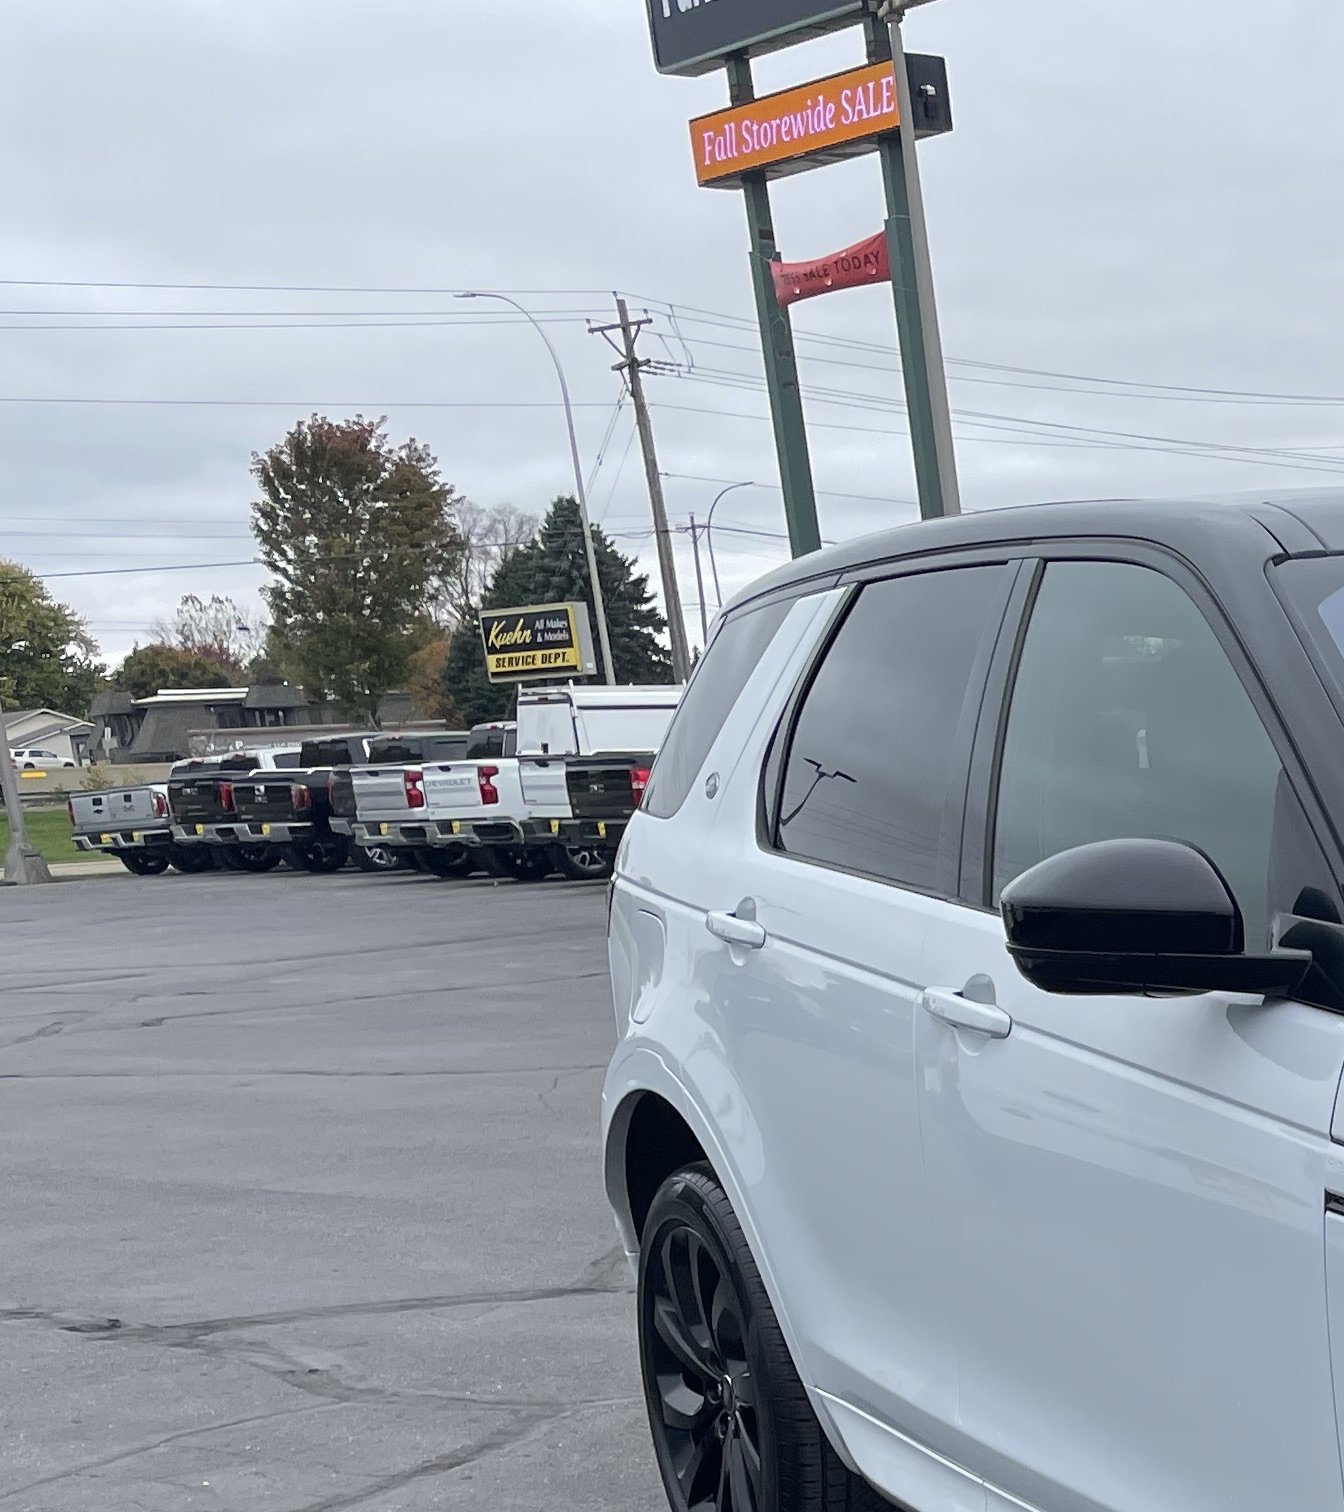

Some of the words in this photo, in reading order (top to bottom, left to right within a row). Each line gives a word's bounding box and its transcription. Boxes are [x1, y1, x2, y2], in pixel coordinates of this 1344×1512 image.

[703, 122, 738, 165] Fall
[741, 95, 836, 153] Storewide
[841, 76, 895, 124] SALE
[833, 250, 880, 274] TODAY
[488, 618, 532, 650] Kuehn
[534, 619, 545, 630] All
[545, 617, 568, 629] Makes
[544, 630, 569, 641] Models
[495, 654, 537, 669] SERVICE
[541, 651, 570, 665] DEPT.
